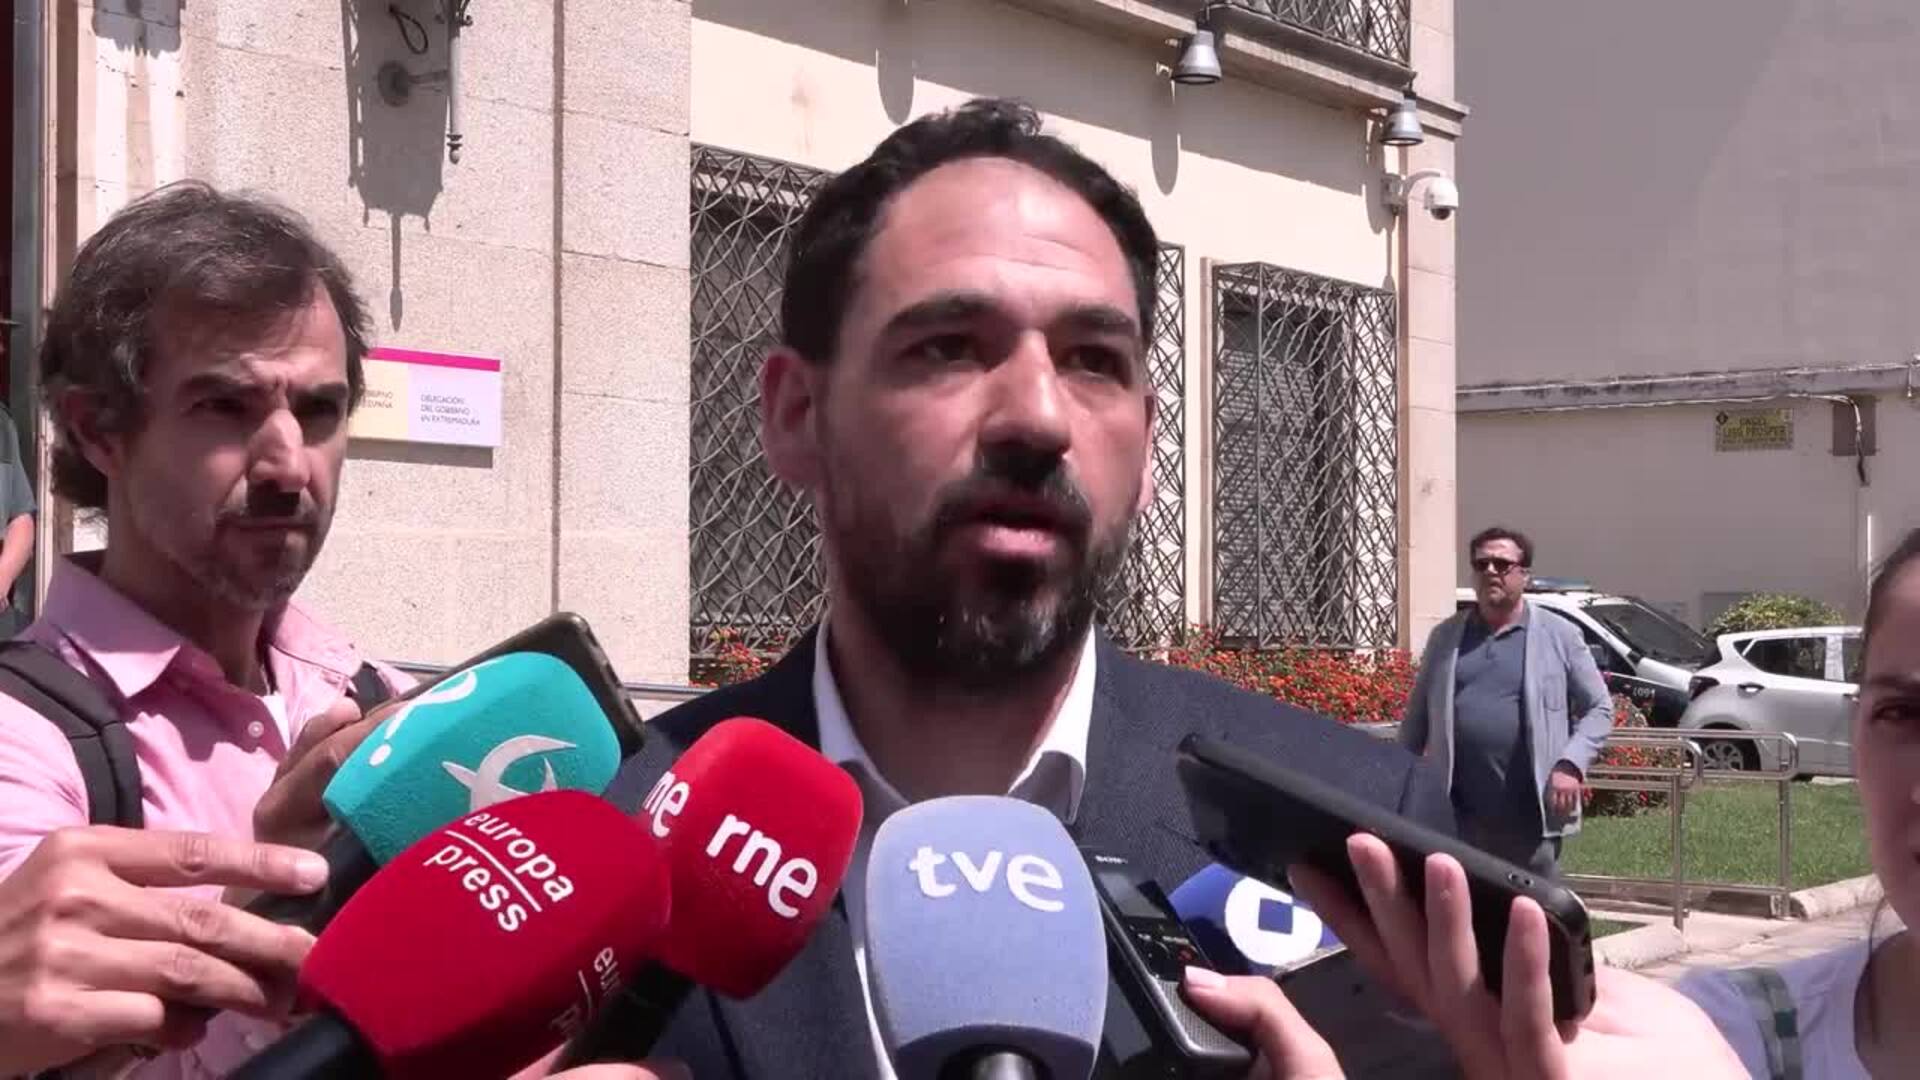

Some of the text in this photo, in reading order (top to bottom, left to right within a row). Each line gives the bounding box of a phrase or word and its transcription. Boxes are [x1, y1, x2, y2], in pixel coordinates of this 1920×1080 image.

[642, 771, 689, 837] ne
[423, 845, 527, 931] press
[464, 812, 574, 902] europa
[706, 814, 818, 917] rne
[909, 847, 1064, 912] tve
